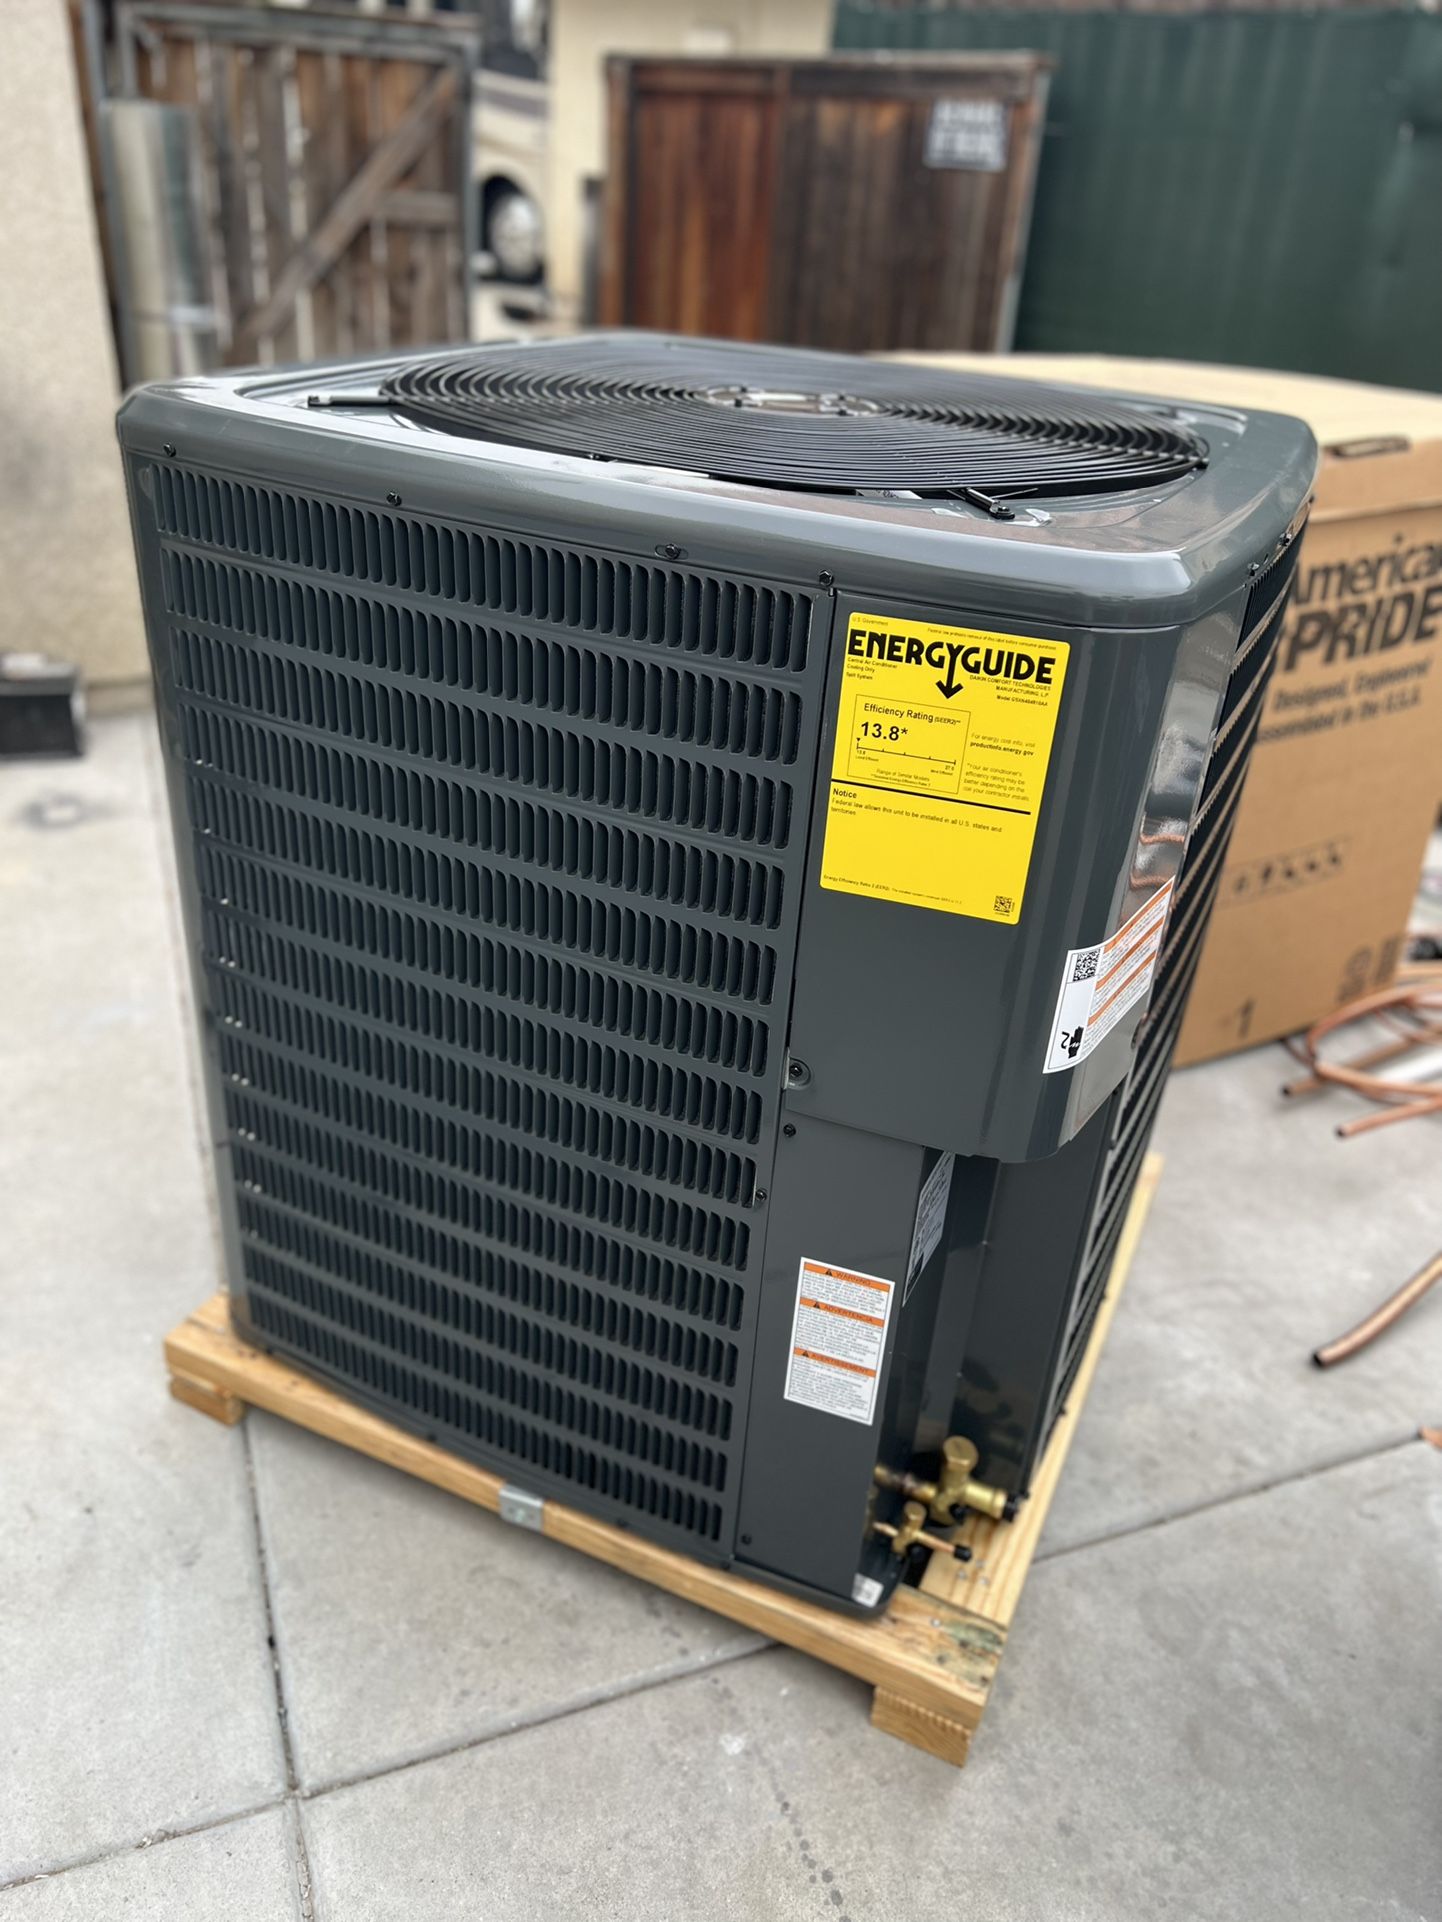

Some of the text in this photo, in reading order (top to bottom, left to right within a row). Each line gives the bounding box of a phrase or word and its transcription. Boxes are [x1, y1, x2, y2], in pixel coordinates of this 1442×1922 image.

[1284, 584, 1442, 671] PRIDE
[848, 628, 1056, 699] ENERGYGUIDE
[988, 678, 1011, 686] COMFORT
[1012, 680, 1051, 691] TECHNOLOGIES
[996, 686, 1038, 696] MANUFACTURING
[864, 702, 905, 718] Efficiency
[906, 710, 934, 723] Rating
[832, 788, 858, 798] Notice
[832, 798, 852, 806] Federal
[864, 804, 881, 812] allows
[920, 814, 944, 822] installed
[972, 823, 990, 831] states
